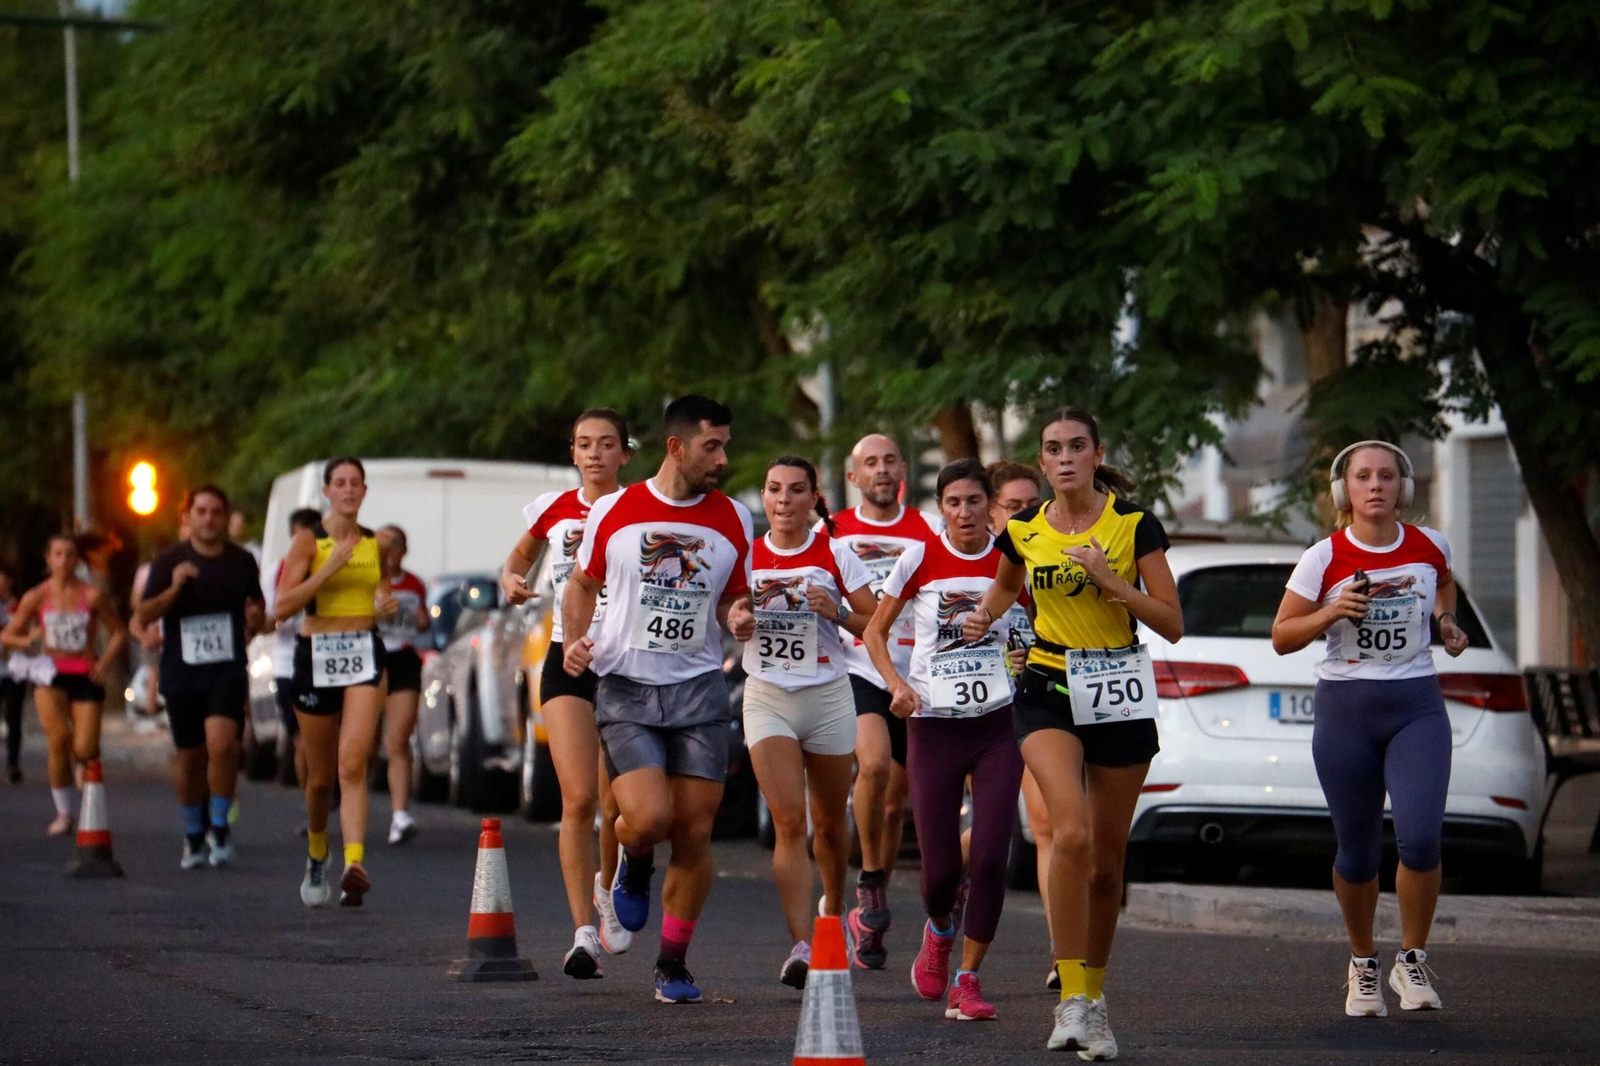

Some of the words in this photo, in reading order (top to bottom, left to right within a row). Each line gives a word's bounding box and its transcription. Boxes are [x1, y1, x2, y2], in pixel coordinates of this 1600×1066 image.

[647, 616, 695, 640] 486
[1357, 628, 1407, 651] 805
[191, 636, 223, 653] 761
[759, 636, 805, 661] 326
[325, 656, 363, 675] 828
[954, 680, 988, 706] 30
[1086, 677, 1144, 709] 750
